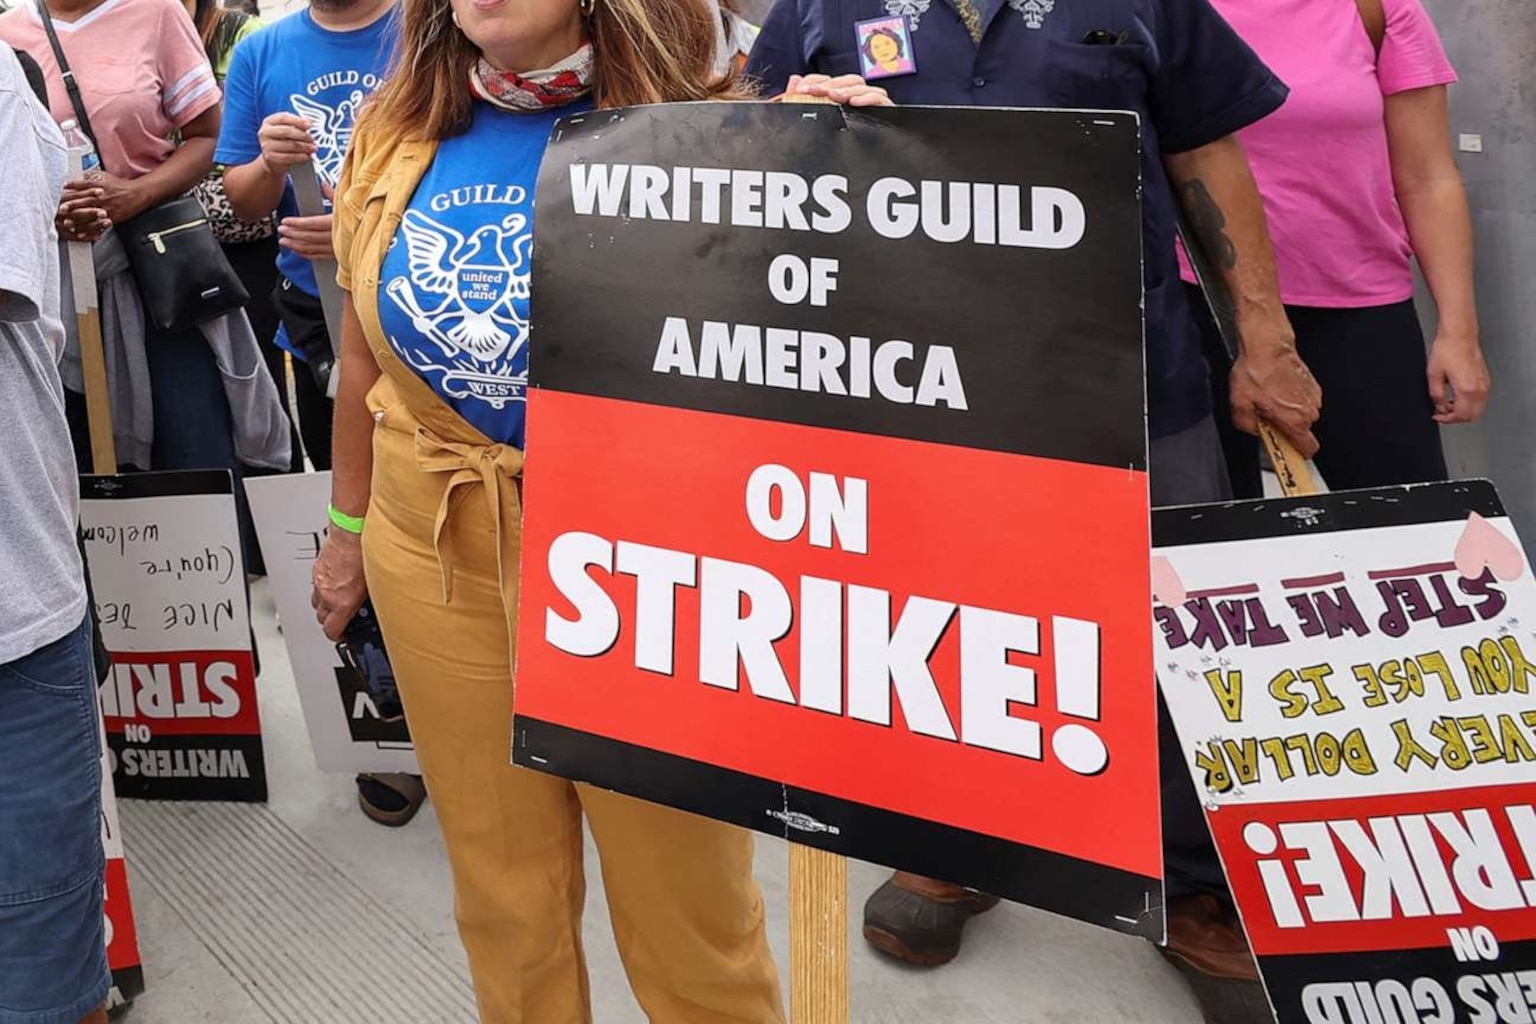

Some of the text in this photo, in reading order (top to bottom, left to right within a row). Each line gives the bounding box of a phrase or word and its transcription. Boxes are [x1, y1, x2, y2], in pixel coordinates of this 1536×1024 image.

[307, 70, 359, 96] GUILD
[430, 183, 527, 212] GUILD
[569, 162, 1086, 250] WRITERS GUILD
[462, 270, 503, 284] united
[462, 288, 497, 301] stand
[473, 282, 489, 291] we
[767, 253, 839, 307] OF
[652, 316, 970, 412] AMERICA
[468, 381, 521, 397] WEST
[745, 463, 869, 555] ON
[83, 525, 159, 556] welcom
[164, 599, 234, 632] NICE
[1154, 567, 1507, 652] STEP WE TAKE
[545, 531, 1109, 777] STRIKE!
[1204, 668, 1242, 722] A
[1268, 663, 1345, 718] IS
[1352, 651, 1460, 708] LOSE
[124, 724, 151, 743] ON
[122, 748, 250, 778] WRITERS
[1195, 729, 1378, 793] DOLLAR
[1446, 925, 1500, 963] ON
